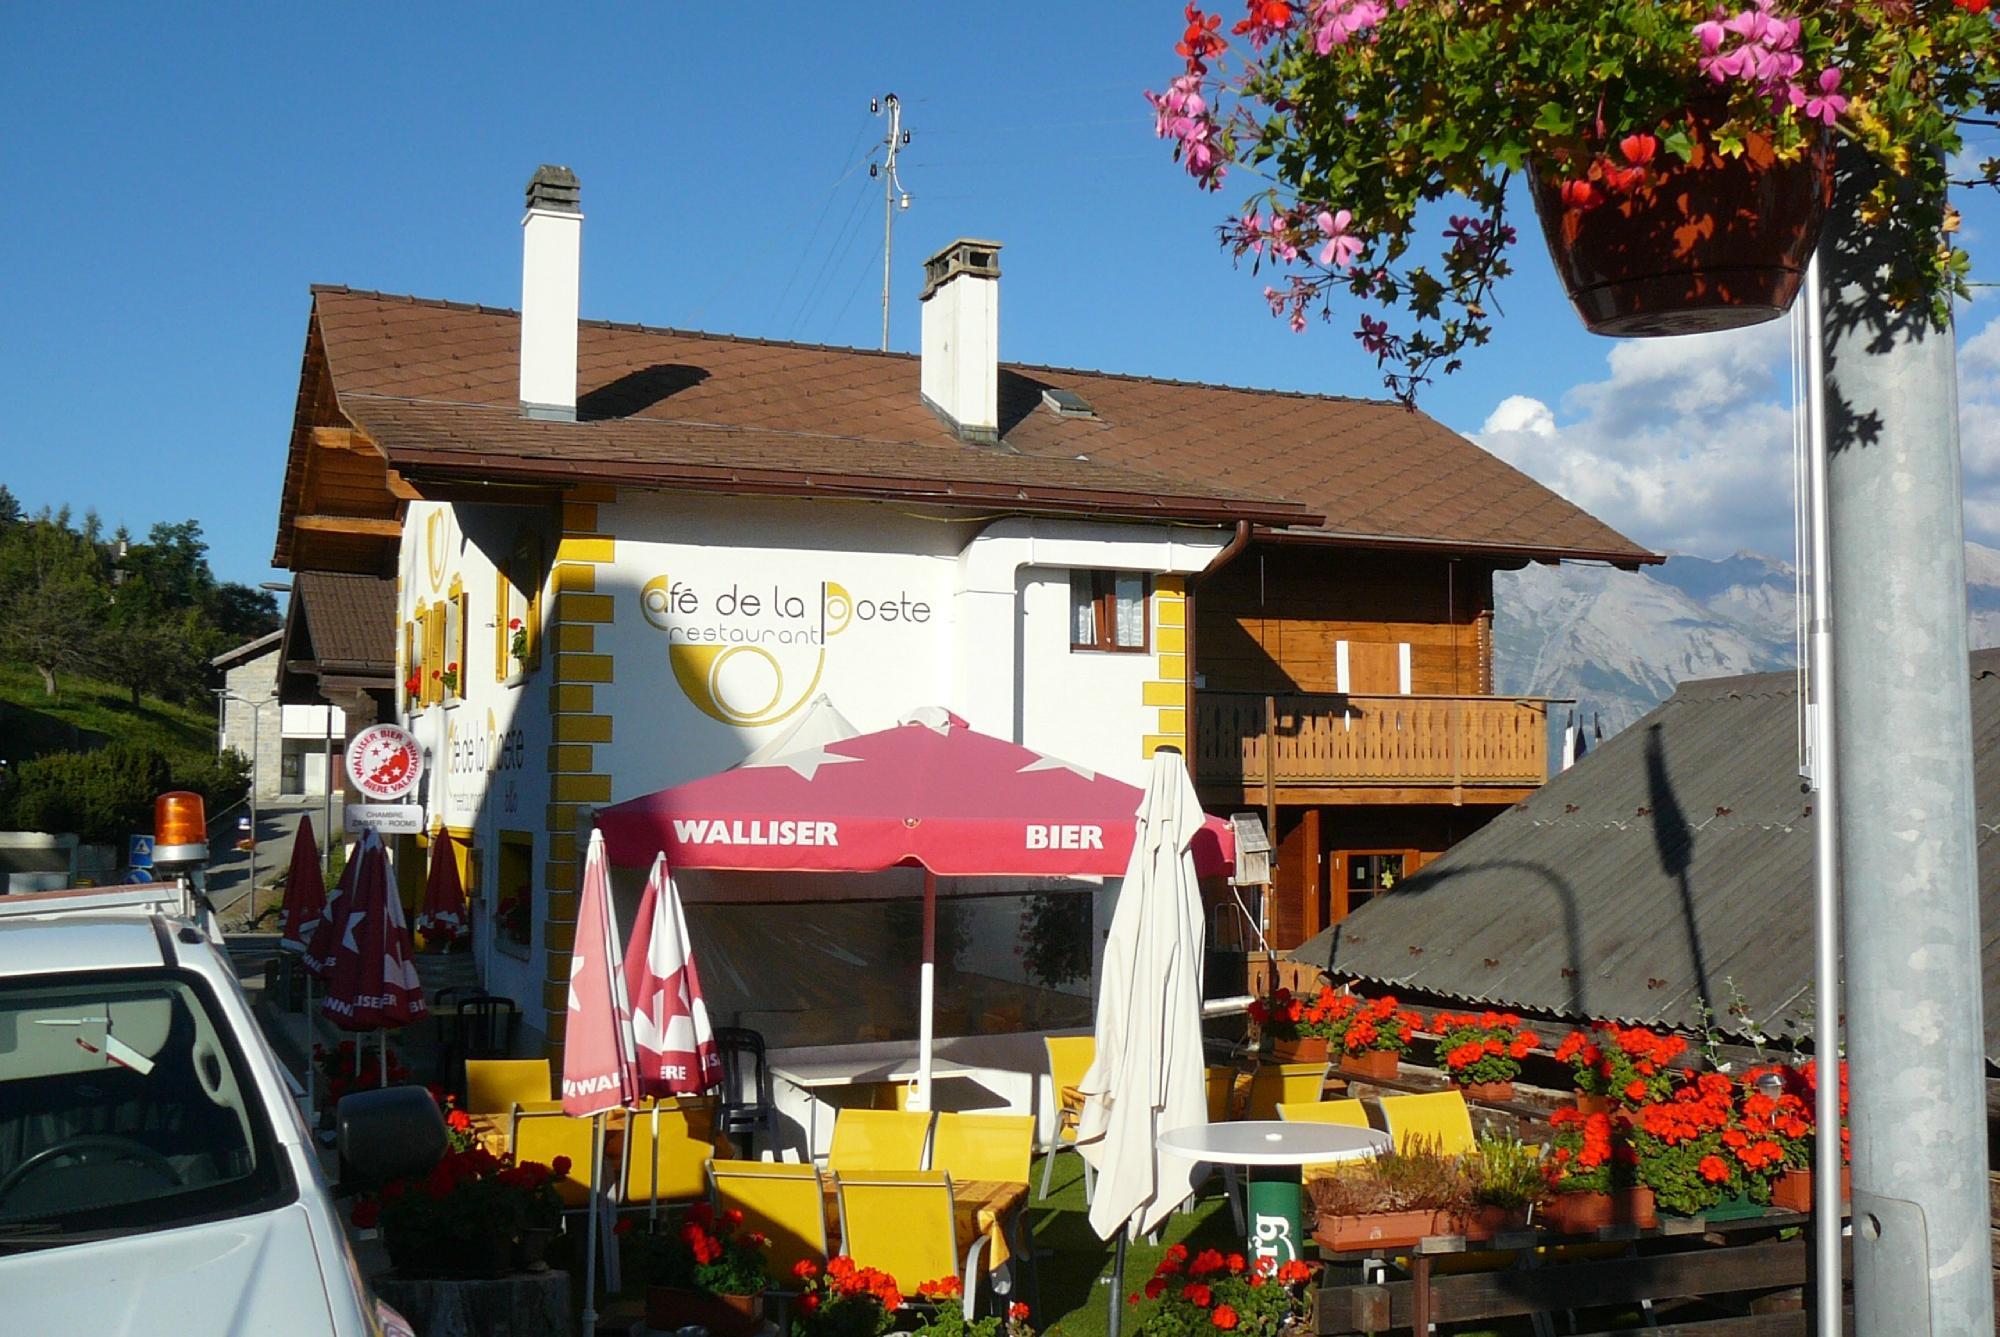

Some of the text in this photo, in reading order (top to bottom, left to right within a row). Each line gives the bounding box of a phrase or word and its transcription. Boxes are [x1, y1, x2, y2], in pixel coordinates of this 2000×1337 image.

[716, 584, 761, 616] de
[774, 585, 804, 618] la
[821, 581, 931, 644] poste
[669, 623, 818, 645] restaurant
[353, 729, 404, 779] WALLISER BIER
[388, 819, 417, 827] ROOMS
[673, 819, 1104, 850] WALLISER BIER
